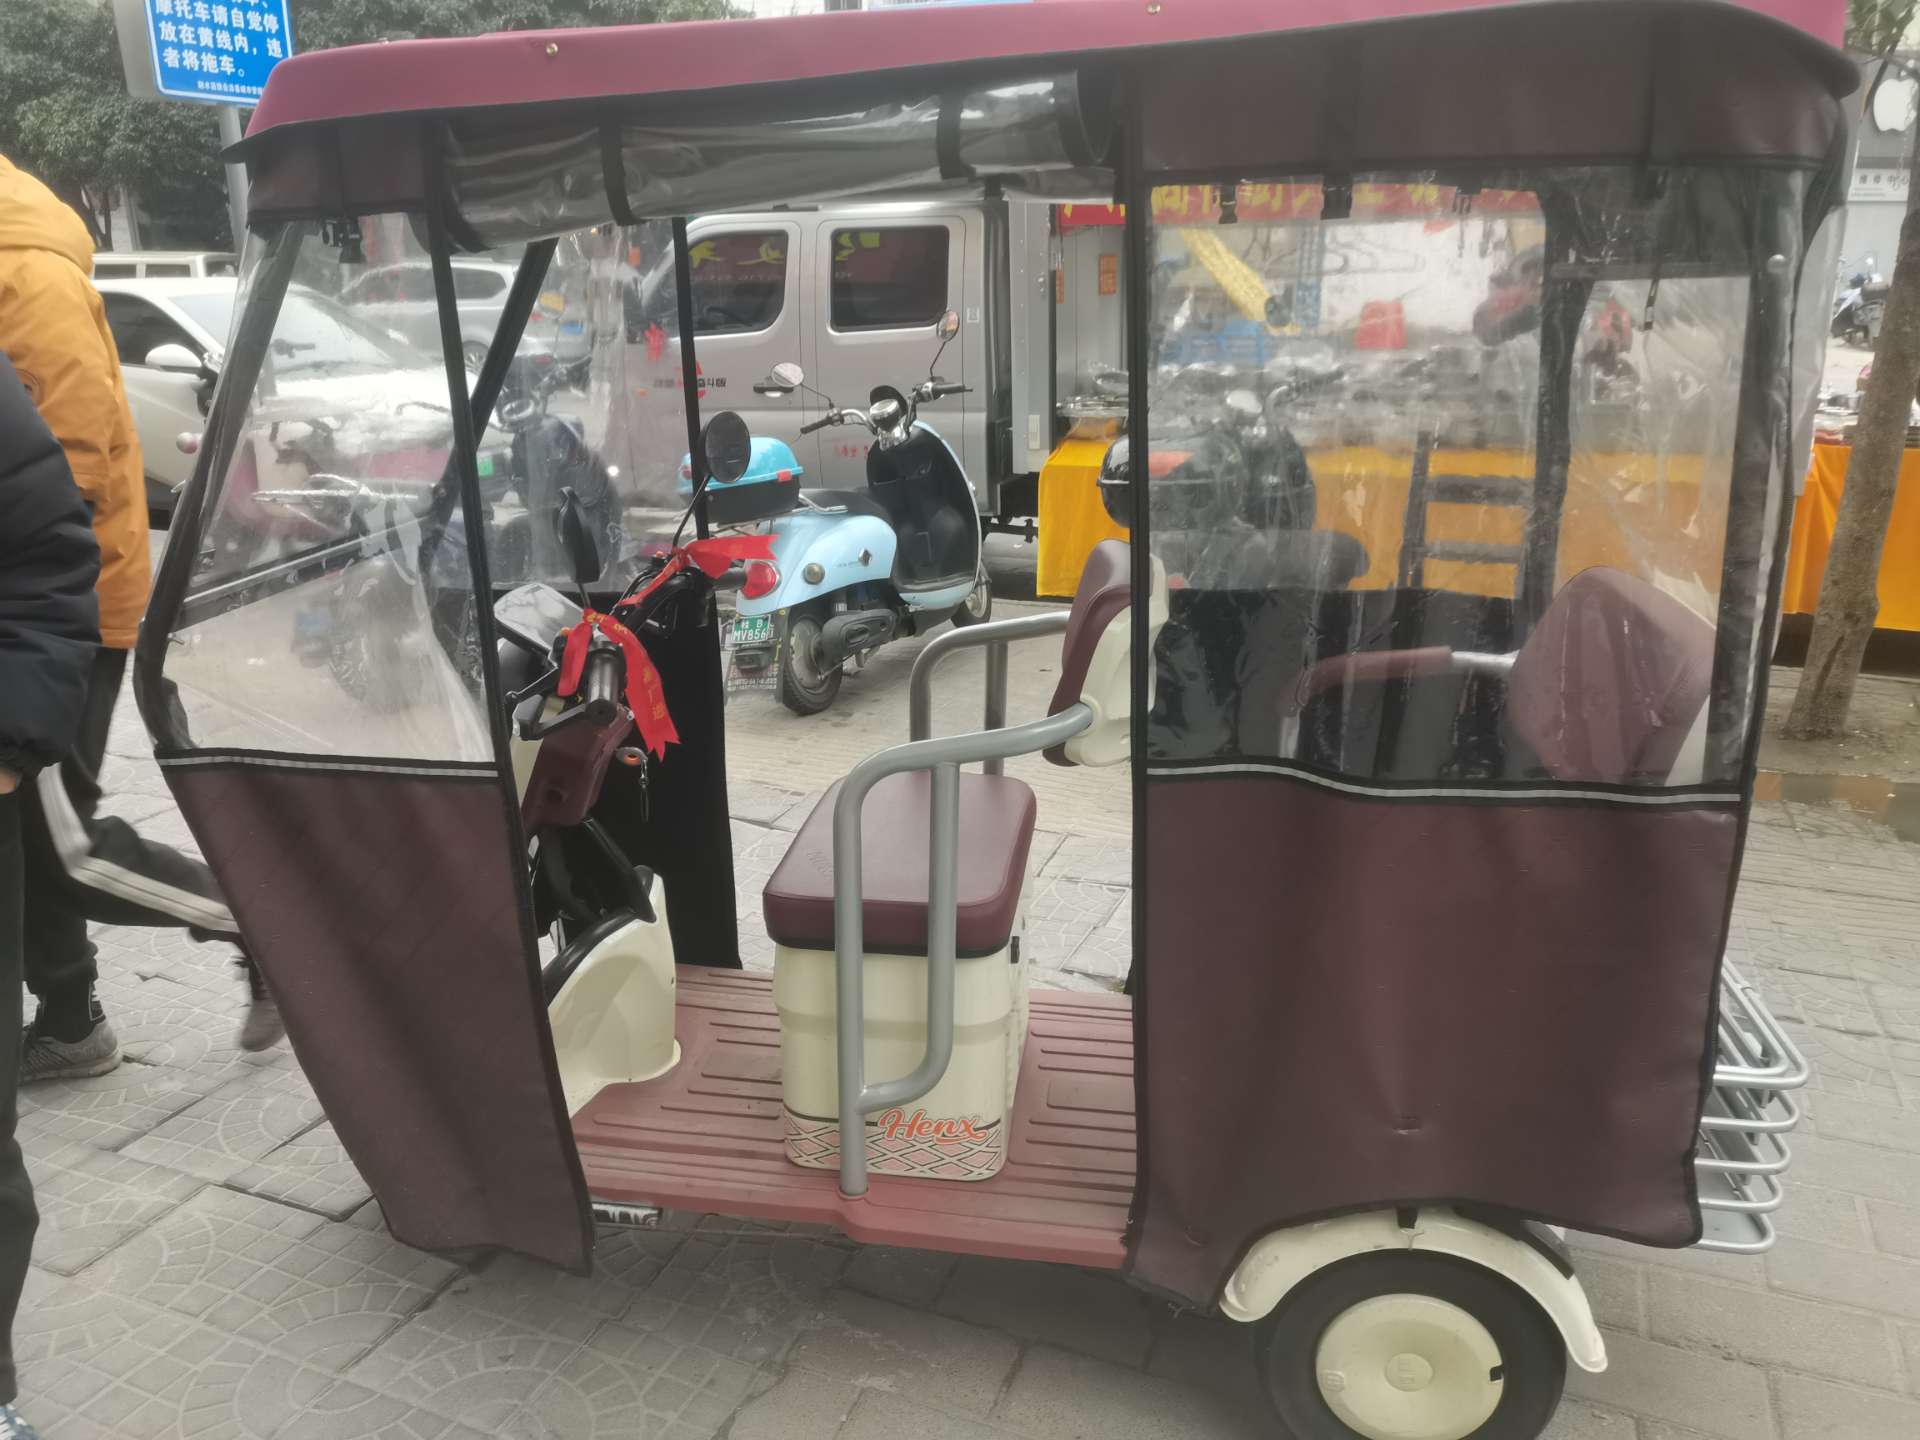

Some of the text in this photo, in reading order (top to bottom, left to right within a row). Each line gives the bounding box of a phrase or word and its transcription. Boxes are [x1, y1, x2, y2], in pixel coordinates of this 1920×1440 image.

[155, 0, 279, 34] 摩托车请自觉停
[159, 21, 283, 58] 放在黄线内，违
[163, 47, 245, 77] 者将拖车。
